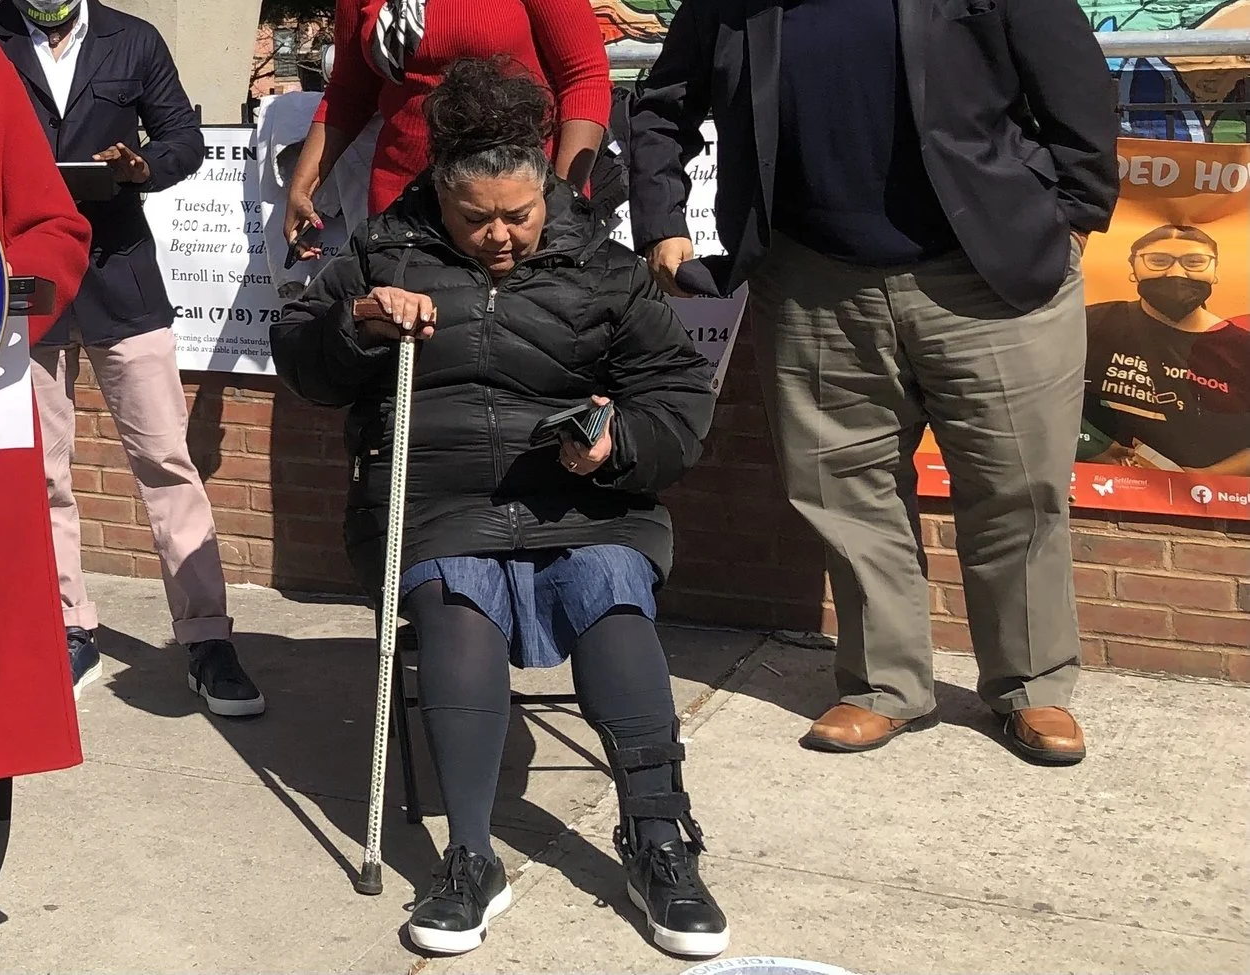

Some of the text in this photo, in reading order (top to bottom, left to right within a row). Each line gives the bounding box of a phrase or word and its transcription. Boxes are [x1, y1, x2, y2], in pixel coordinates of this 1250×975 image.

[204, 145, 226, 160] EE
[186, 167, 248, 182] or Adults
[1194, 158, 1250, 194] HO
[174, 198, 234, 216] Tuesday,
[172, 219, 198, 232] 9:00
[202, 222, 231, 233] a.m.
[169, 238, 227, 256] Beginner
[230, 244, 243, 254] to
[246, 241, 267, 255] ad
[171, 268, 208, 282] Enroll
[212, 270, 224, 283] in
[173, 305, 281, 325] Call (718) 78
[174, 333, 202, 344] Evening
[226, 336, 239, 344] and
[239, 336, 270, 348] Saturday
[186, 345, 200, 353] also
[201, 345, 230, 355] available
[231, 347, 239, 355] in
